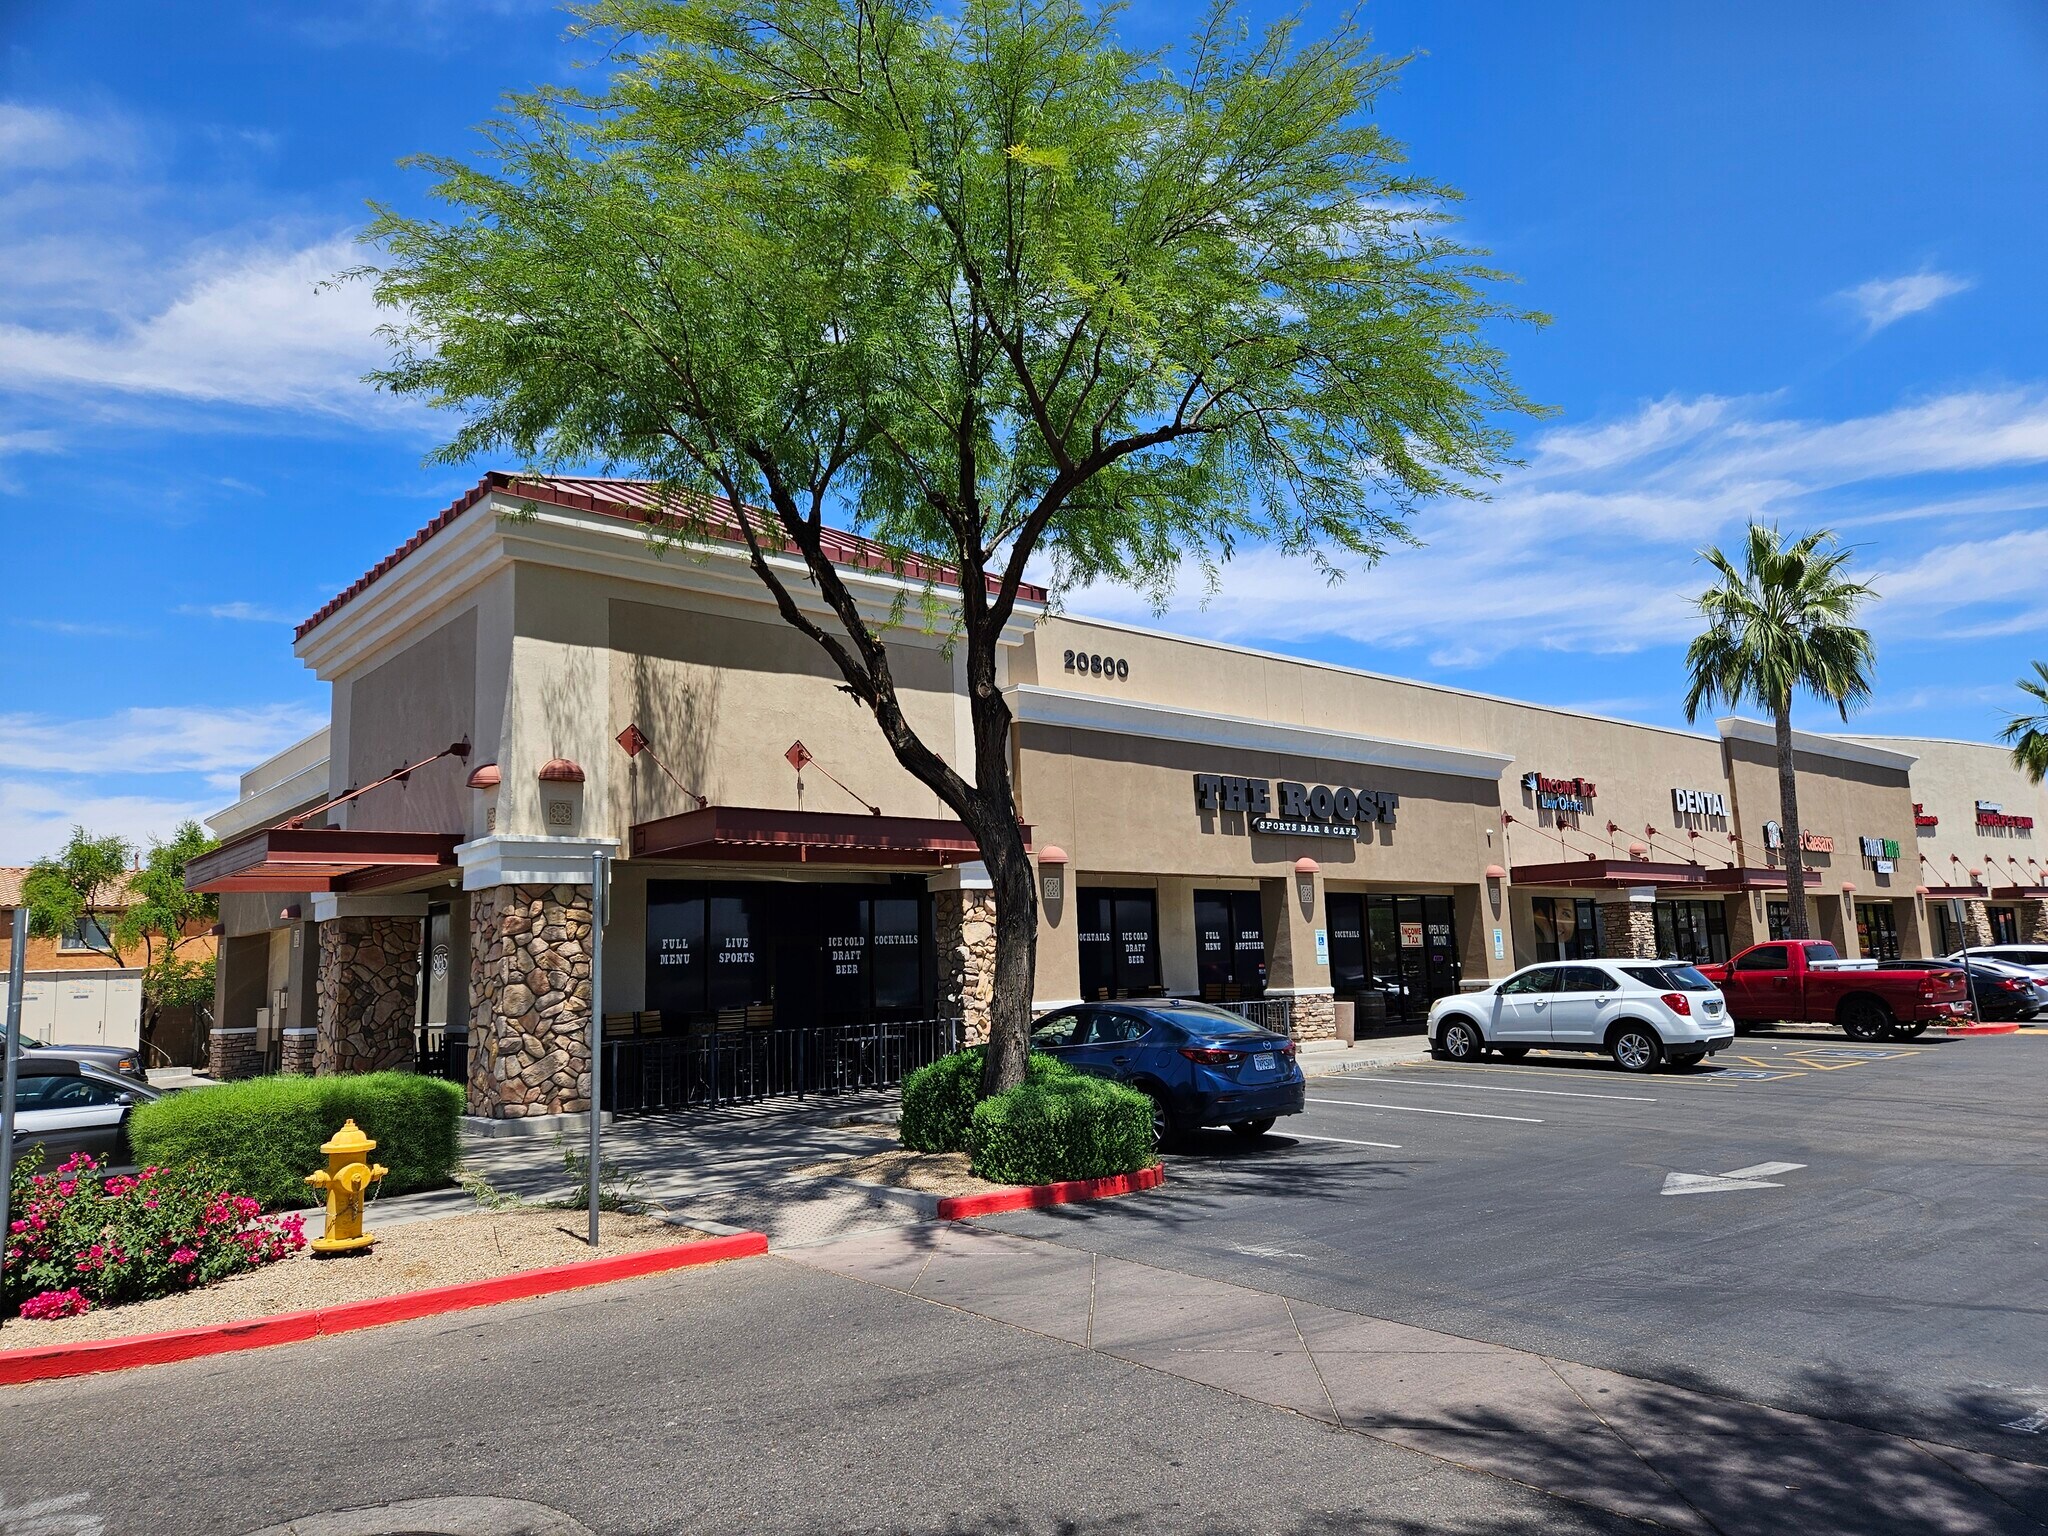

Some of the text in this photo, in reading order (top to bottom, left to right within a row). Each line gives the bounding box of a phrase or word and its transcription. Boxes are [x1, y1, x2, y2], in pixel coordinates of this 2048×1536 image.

[1063, 649, 1129, 678] 20800
[1536, 773, 1597, 797] INCOME TAX
[1195, 774, 1400, 823] THE ROOST
[1541, 794, 1584, 813] LAW OFFICE
[1673, 788, 1731, 817] DENTAL
[1259, 821, 1358, 836] SPORTS BAR & CAFE
[1803, 829, 1835, 853] Caesars
[1241, 931, 1259, 939] GREAT
[1334, 930, 1360, 938] COCKTAILS
[1401, 926, 1422, 936] INCOME
[1428, 924, 1450, 935] OPEN YEAR
[874, 934, 919, 945] COCKTAILS
[1078, 932, 1111, 942] OCKTAILS
[1122, 932, 1149, 941] ICE COLD
[1205, 931, 1220, 940] FULL
[1407, 933, 1419, 944] TAX
[1433, 935, 1447, 946] ROUND
[662, 938, 689, 949] FULL
[725, 937, 749, 948] LIVE
[828, 936, 865, 947] ICE COLD
[1204, 942, 1222, 951] MENU
[1125, 943, 1146, 953] DRAFT
[660, 953, 691, 965] MENU
[719, 952, 755, 963] SPORTS
[832, 950, 862, 961] DRAFT
[1128, 955, 1145, 964] BEER
[433, 953, 448, 971] 805
[836, 964, 859, 975] BEER
